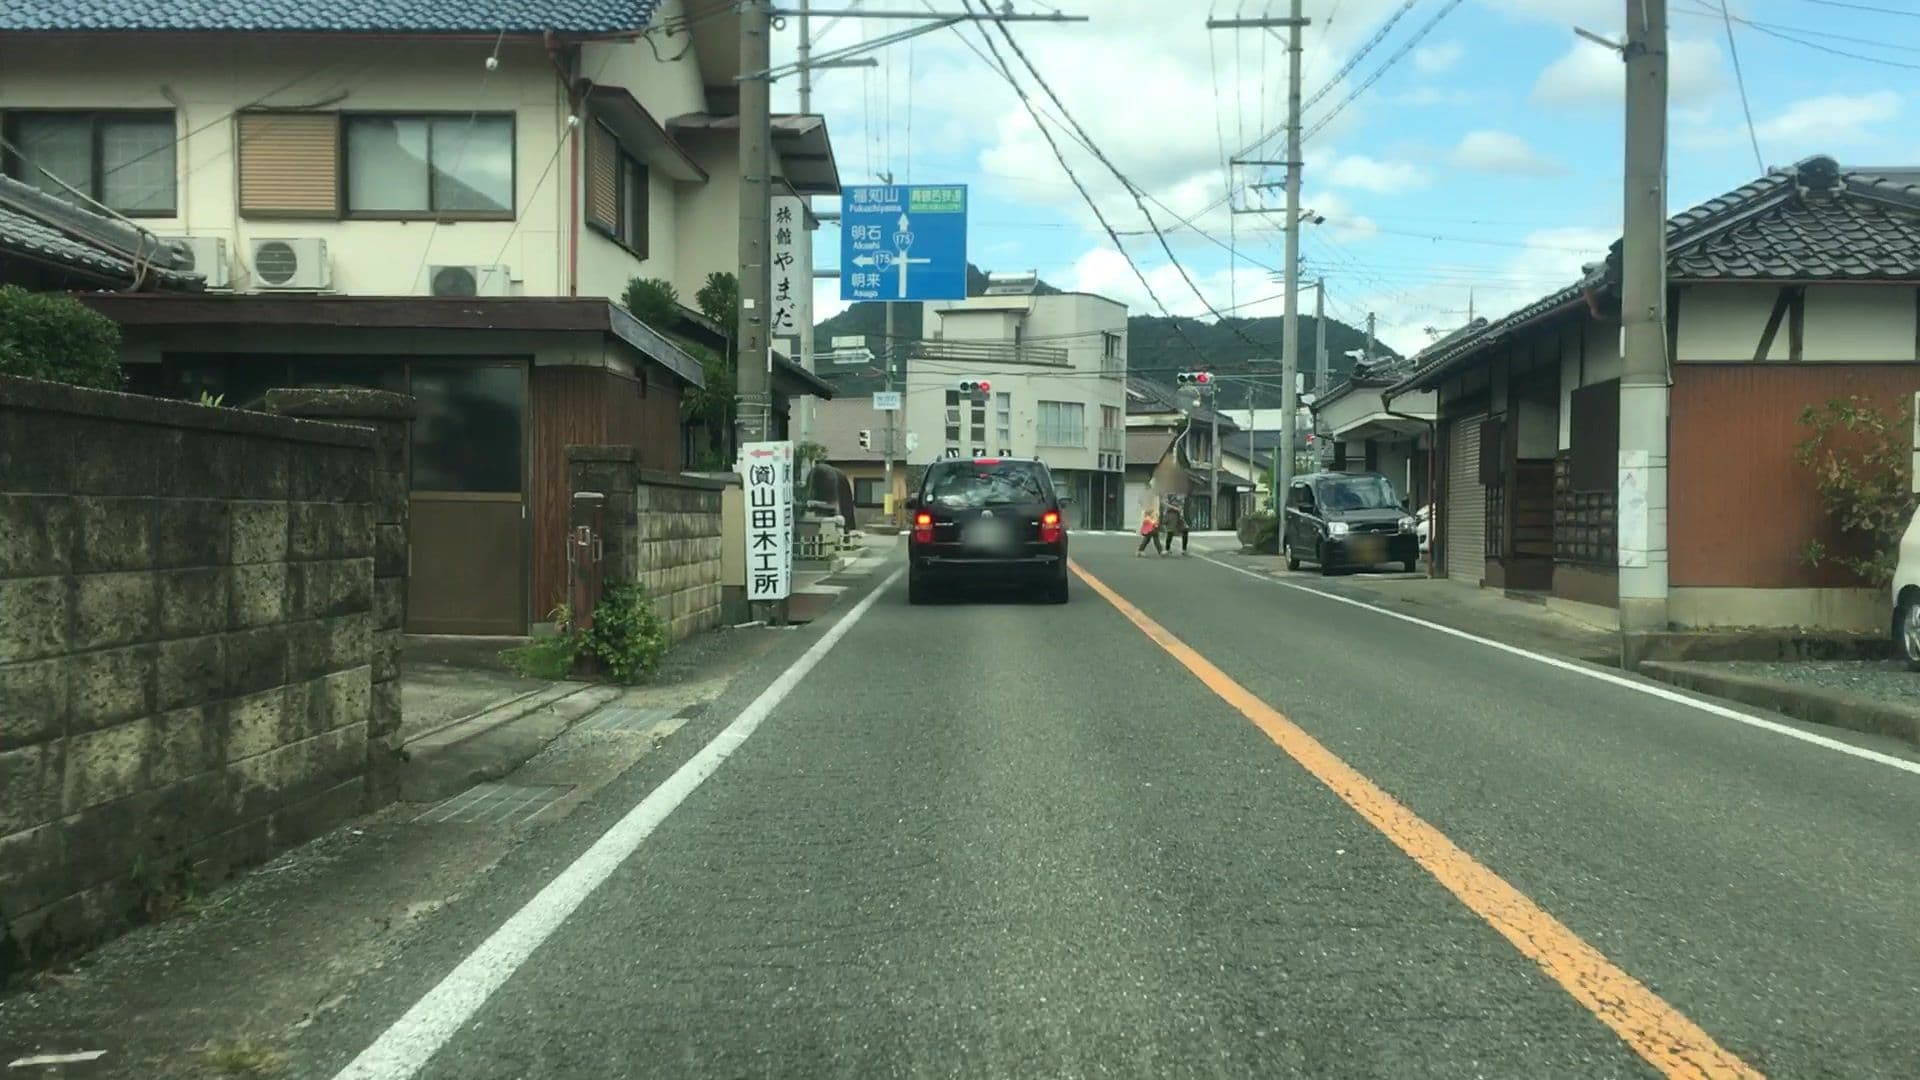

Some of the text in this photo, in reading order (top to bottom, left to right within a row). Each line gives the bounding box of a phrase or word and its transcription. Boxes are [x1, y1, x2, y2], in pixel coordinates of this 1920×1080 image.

[851, 225, 882, 241] 明石
[896, 234, 911, 244] 175
[875, 254, 890, 264] 175
